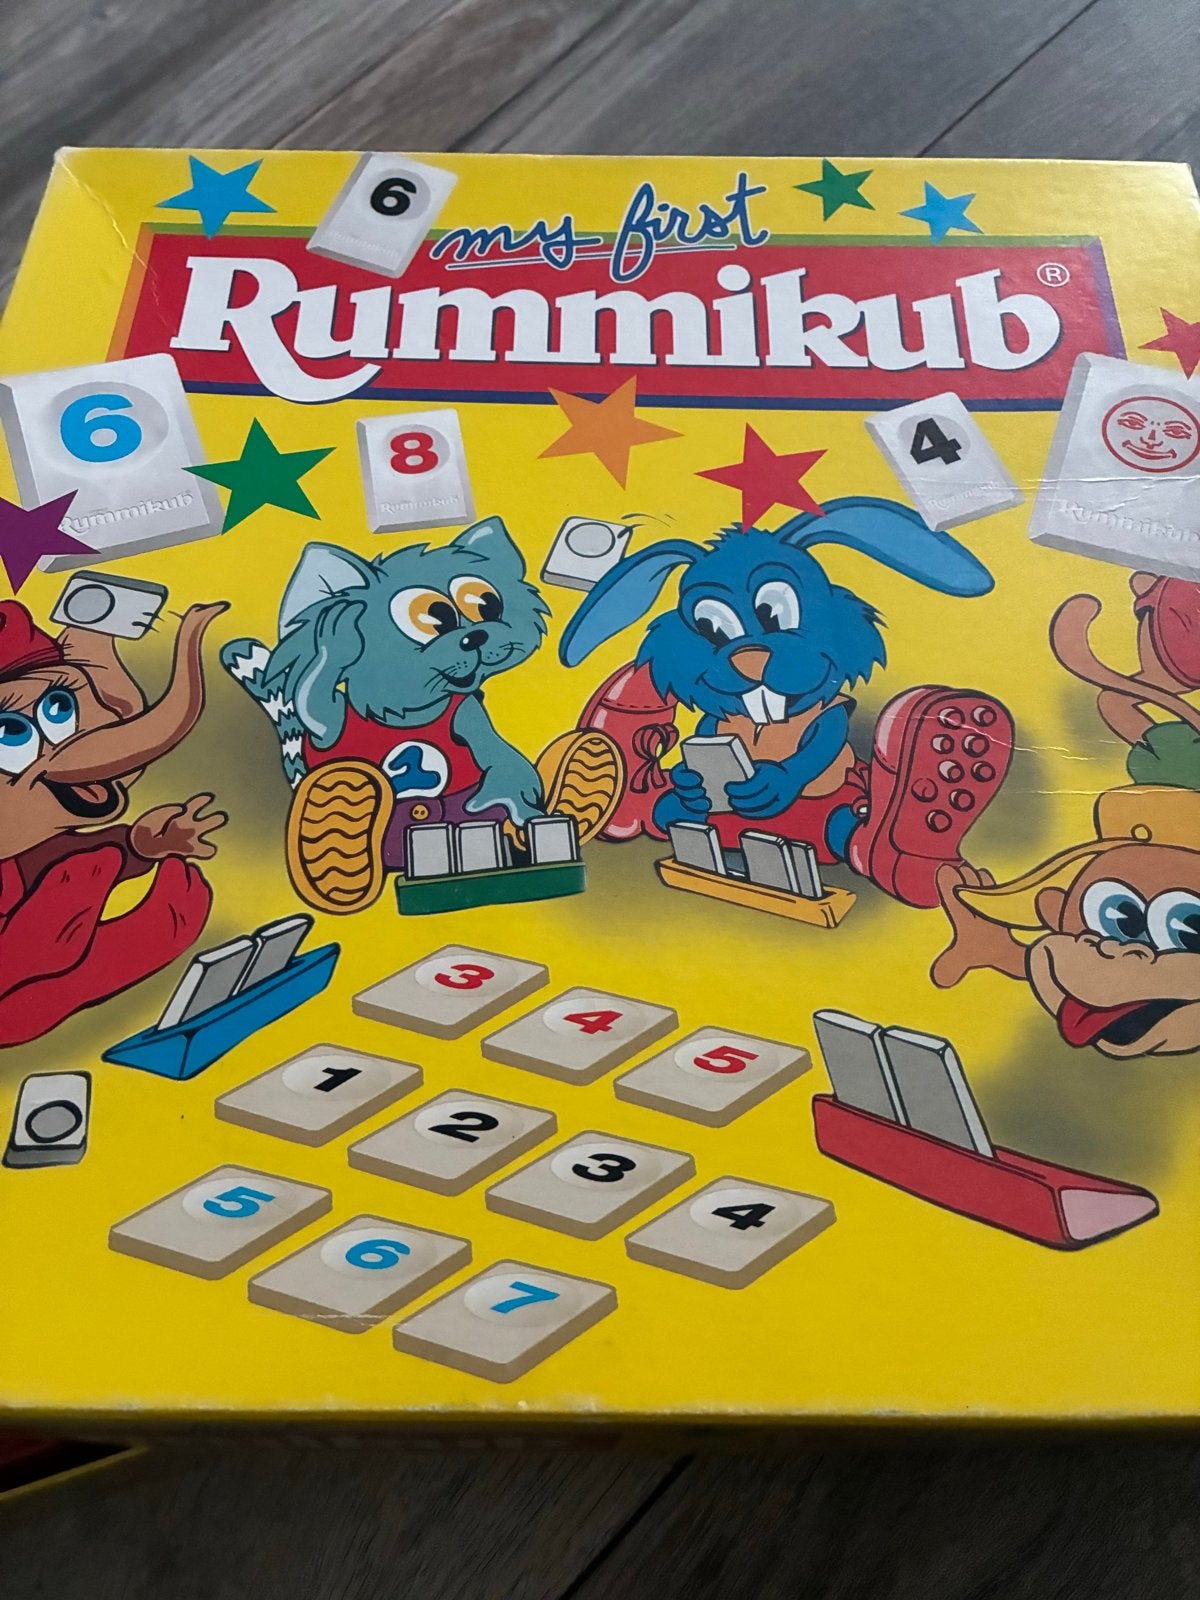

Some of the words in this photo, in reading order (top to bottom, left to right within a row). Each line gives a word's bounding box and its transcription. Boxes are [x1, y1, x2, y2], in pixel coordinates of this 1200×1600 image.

[370, 178, 416, 216] 6
[430, 215, 601, 268] my
[611, 172, 769, 281] first
[169, 255, 1061, 403] Rummikub
[59, 393, 143, 463] 6
[910, 417, 962, 465] 4
[389, 432, 439, 475] 8
[435, 964, 494, 990] 3
[565, 1009, 622, 1035] 4
[694, 1046, 758, 1074] 5
[313, 1067, 363, 1093] 1
[428, 1111, 500, 1143] 2
[572, 1153, 637, 1183] 3
[203, 1186, 275, 1219] 5
[711, 1203, 776, 1231] 4
[345, 1239, 411, 1270] 6
[491, 1281, 560, 1314] 7
